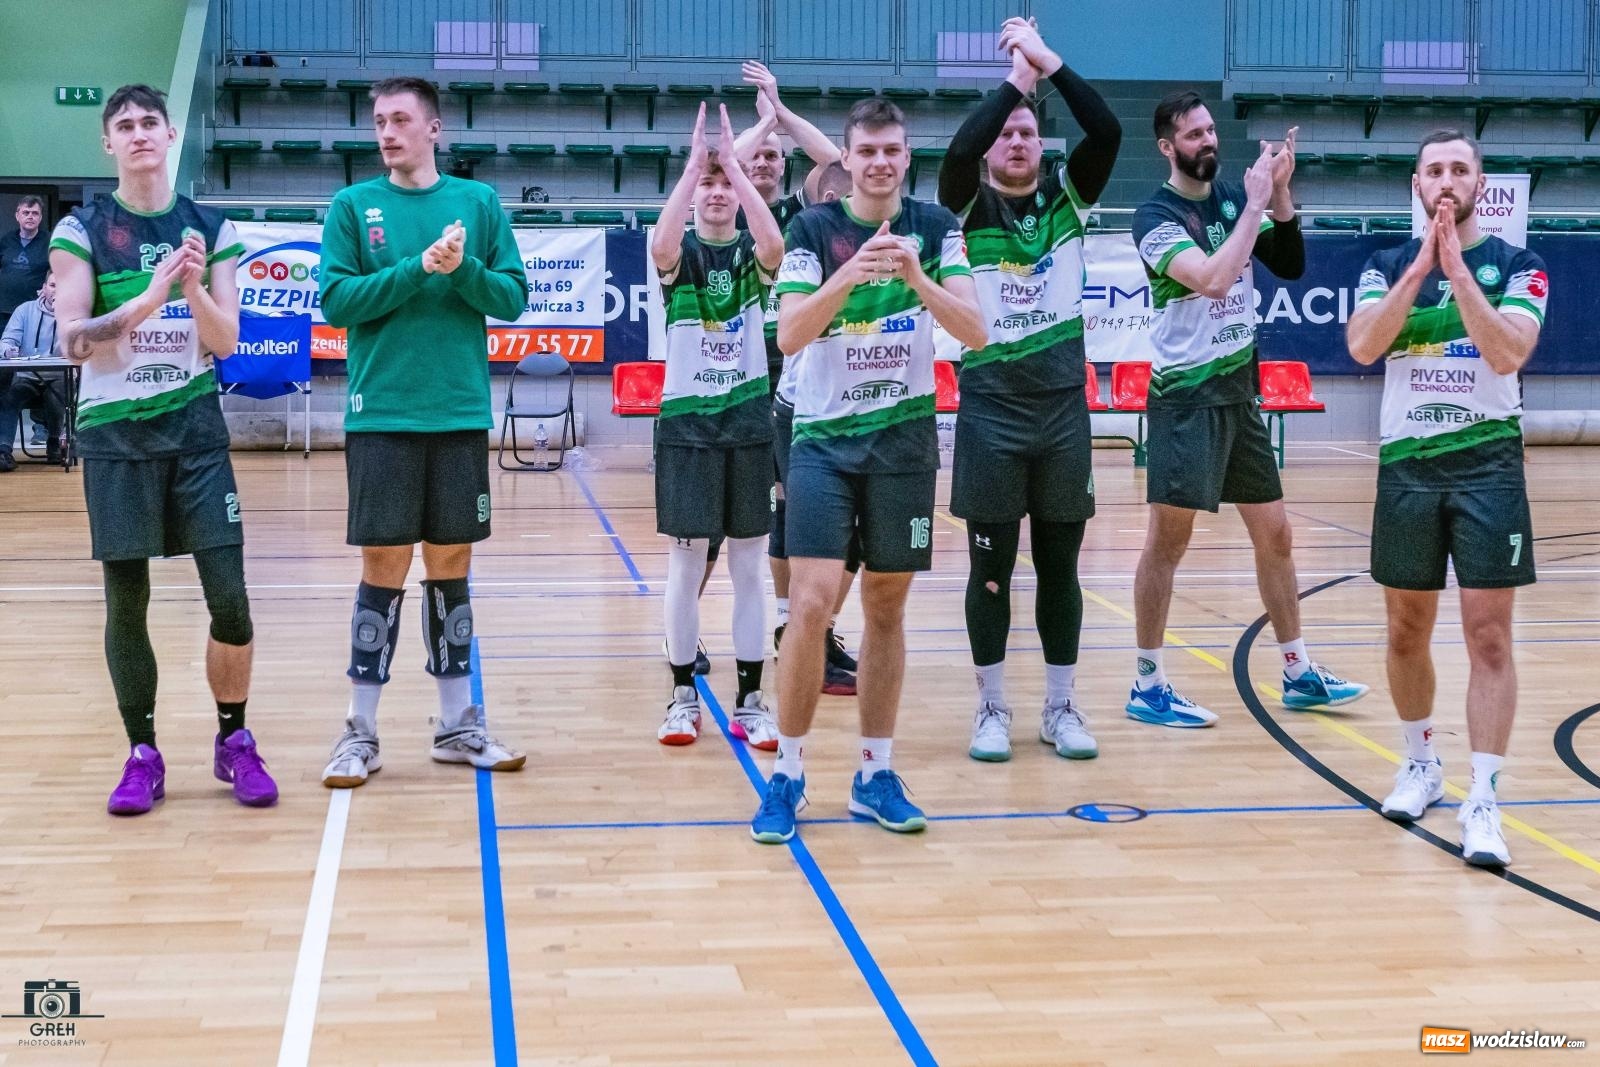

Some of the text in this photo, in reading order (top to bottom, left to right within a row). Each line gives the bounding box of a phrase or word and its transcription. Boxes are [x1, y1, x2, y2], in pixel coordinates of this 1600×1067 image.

[1475, 206, 1514, 217] LOGY
[555, 280, 573, 292] 69
[237, 287, 321, 309] BEZPIE
[1436, 280, 1453, 309] 7
[576, 300, 585, 312] 3
[1253, 286, 1360, 324] RACI
[1100, 317, 1124, 331] 94,9
[130, 330, 190, 344] PIVEXIN
[504, 334, 531, 355] 77
[536, 334, 561, 353] 55
[567, 334, 594, 355] 77
[234, 339, 299, 355] molten
[846, 344, 911, 361] PIVEXIN
[847, 359, 911, 371] TECHNOLOGY
[1410, 368, 1476, 384] PIVEXIN
[1410, 383, 1476, 394] TECHNOLOGY
[350, 394, 363, 413] 10
[909, 516, 930, 549] 16
[1509, 533, 1523, 567] 7
